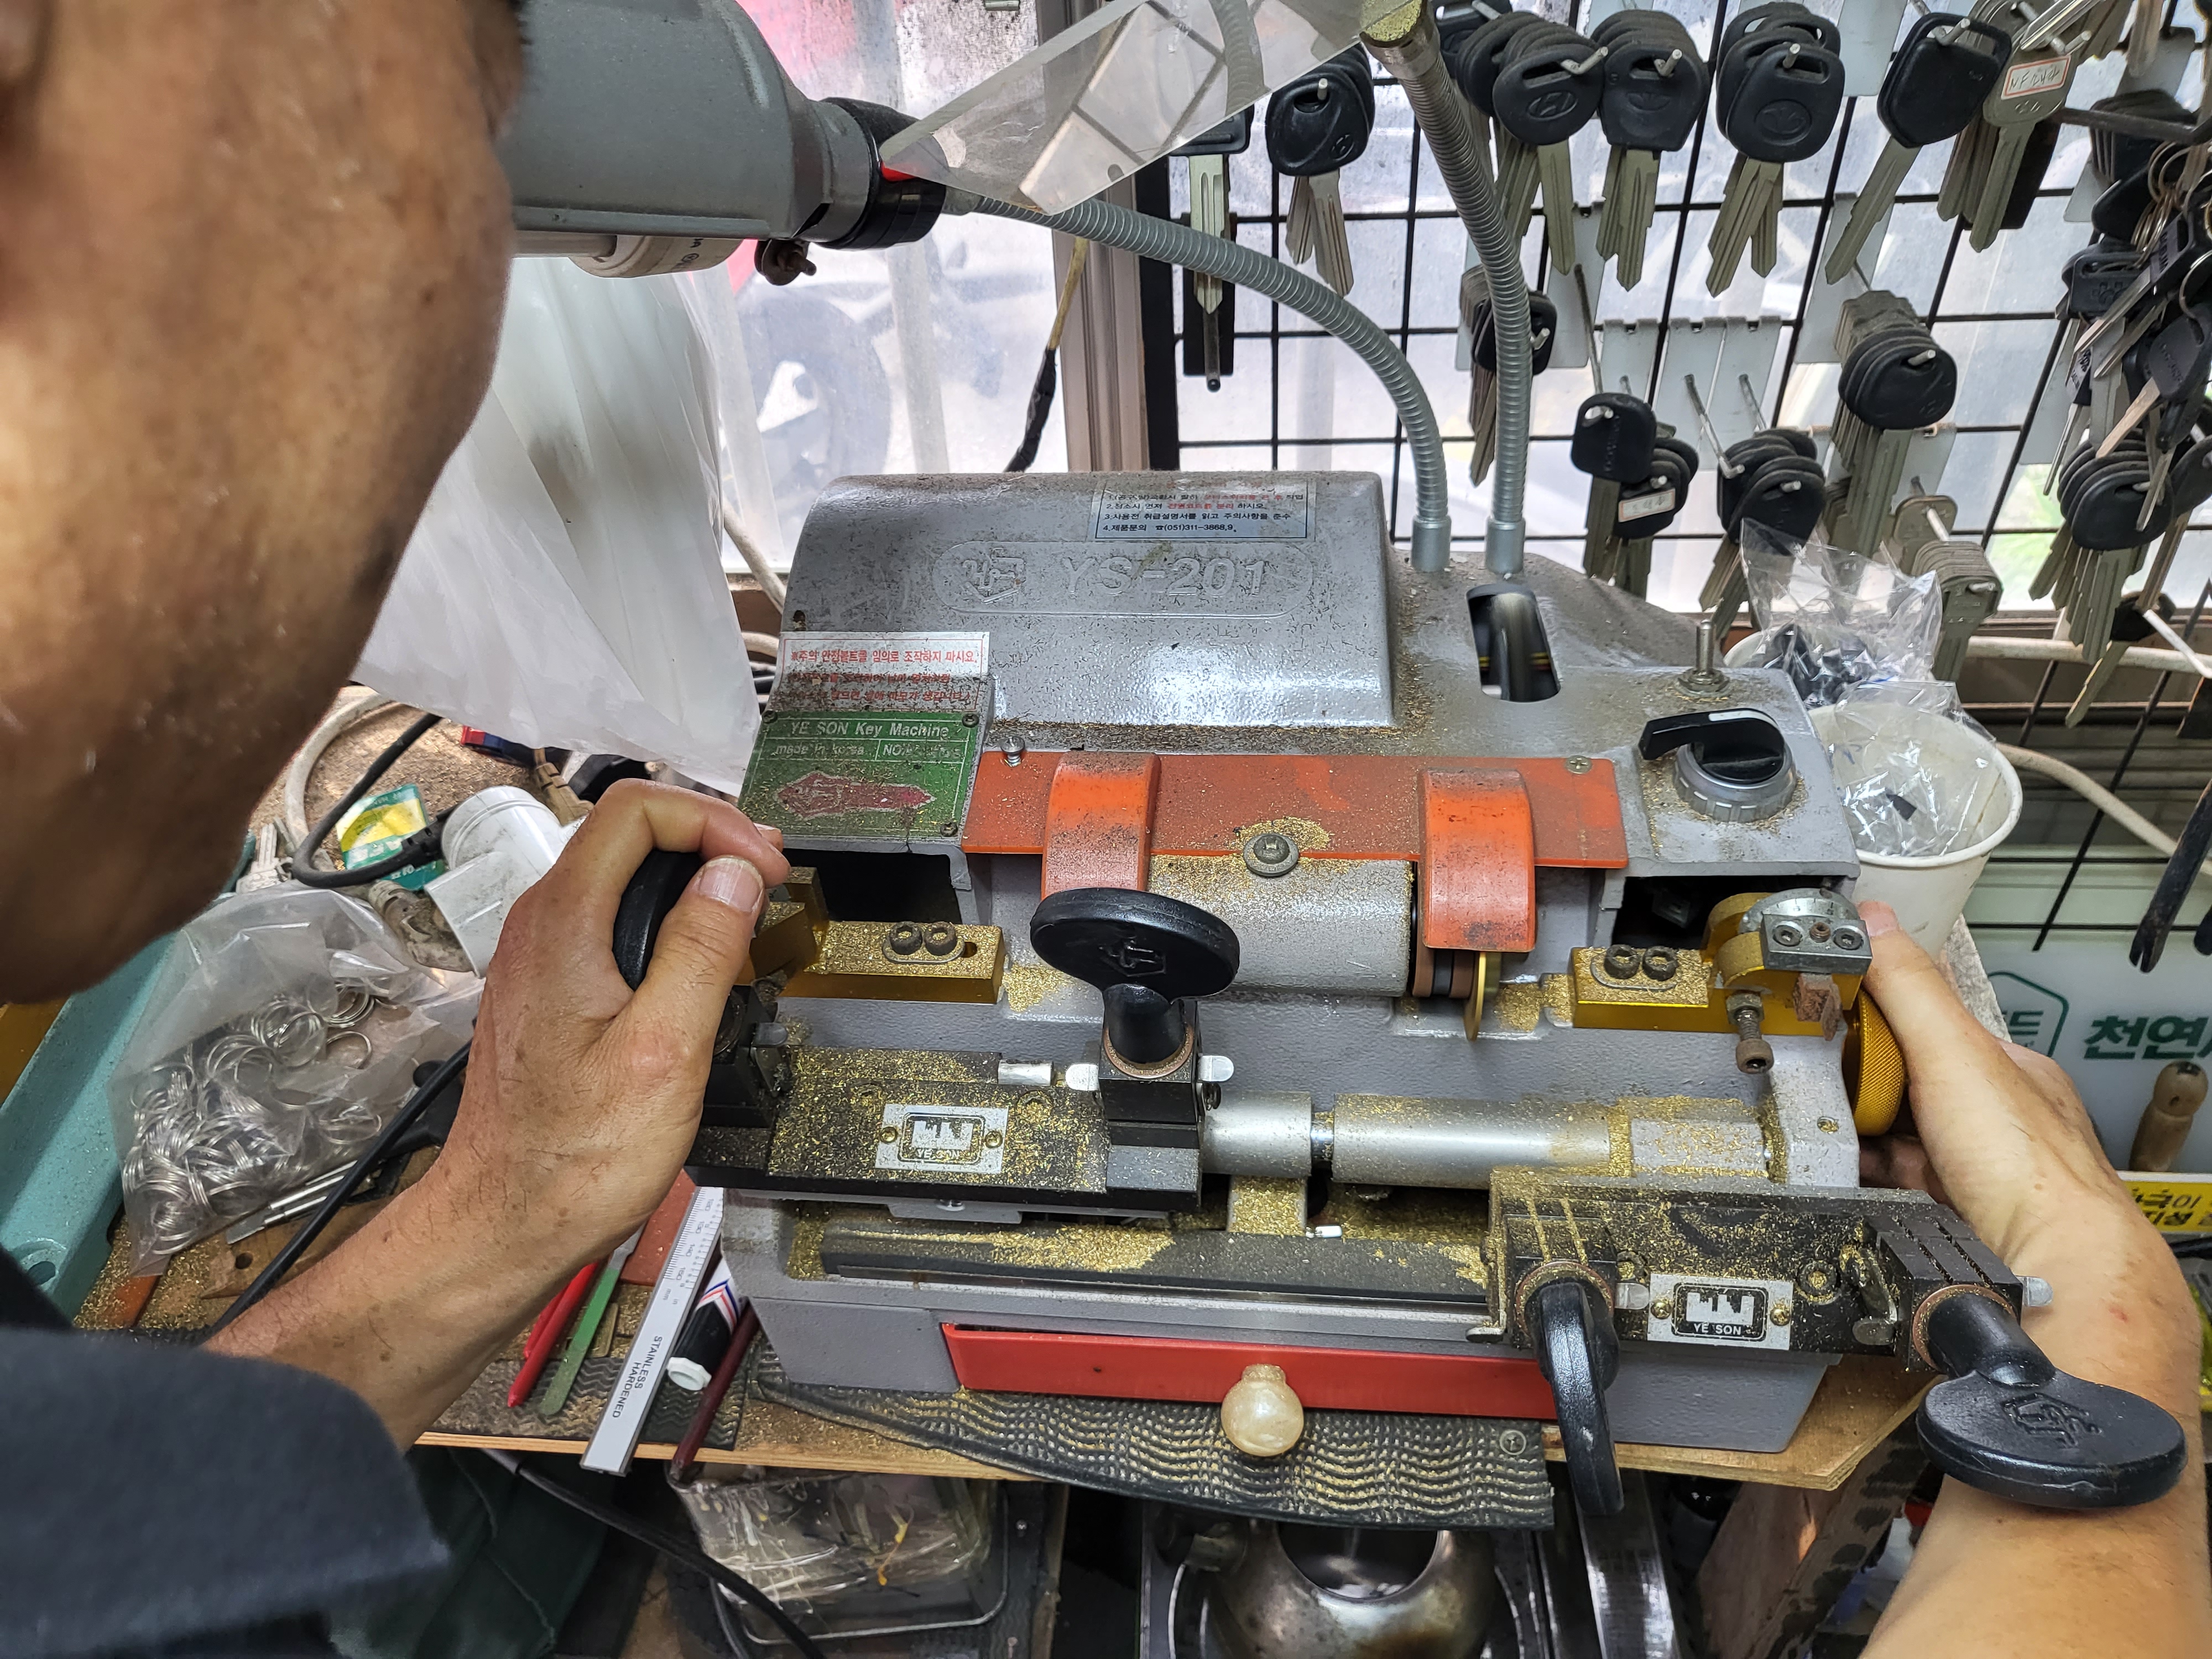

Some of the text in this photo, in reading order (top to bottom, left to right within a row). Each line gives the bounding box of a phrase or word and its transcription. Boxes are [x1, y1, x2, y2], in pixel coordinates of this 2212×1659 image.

[1064, 556, 1264, 598] YS-201
[821, 649, 867, 662] 안전볼트를
[872, 650, 899, 662] 임의로
[904, 650, 942, 662] 조작하지
[791, 722, 950, 738] YE SON Key Machine
[2002, 1010, 2043, 1036] 드
[2083, 1015, 2212, 1061] 천연
[662, 1288, 672, 1300] mm
[1694, 1323, 1742, 1336] YE SON
[634, 1334, 663, 1390] STAINLESS
[612, 1361, 641, 1418] HARDENED
